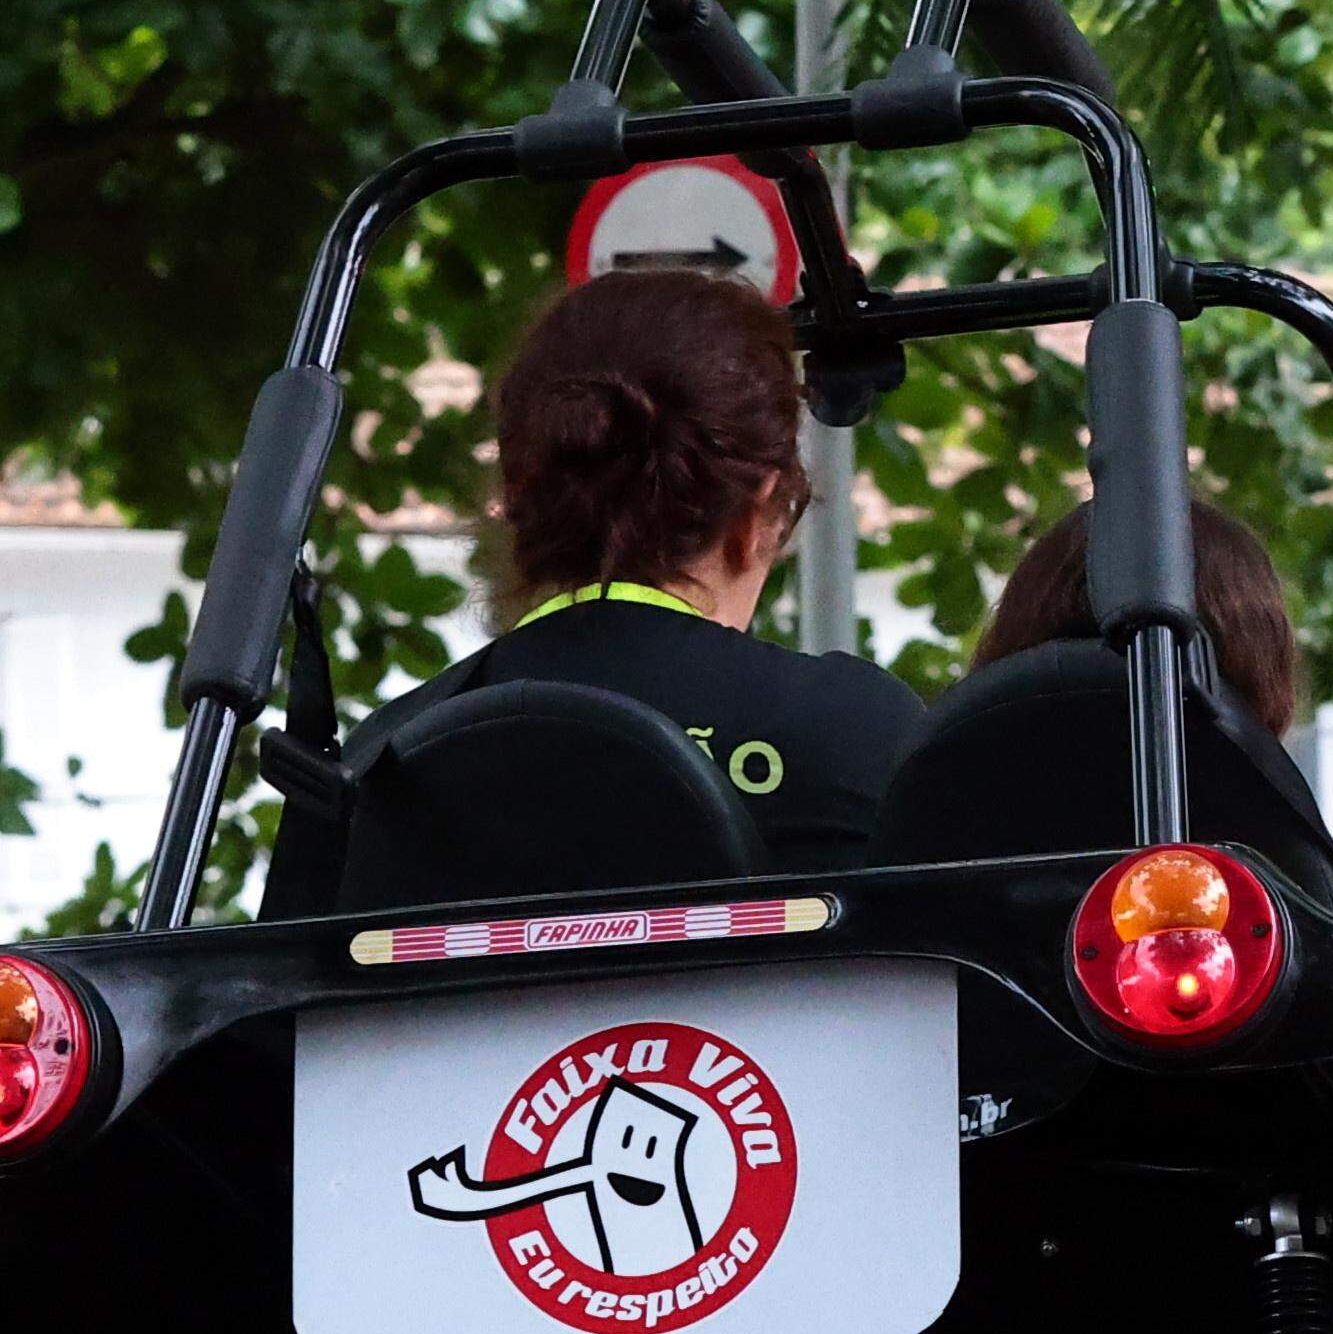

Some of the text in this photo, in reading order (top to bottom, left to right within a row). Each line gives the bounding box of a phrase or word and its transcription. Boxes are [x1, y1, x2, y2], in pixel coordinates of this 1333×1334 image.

[534, 918, 638, 943] FAPINHA
[504, 1039, 782, 1169] Faixa Viva
[508, 1227, 759, 1328] Eu respeito
